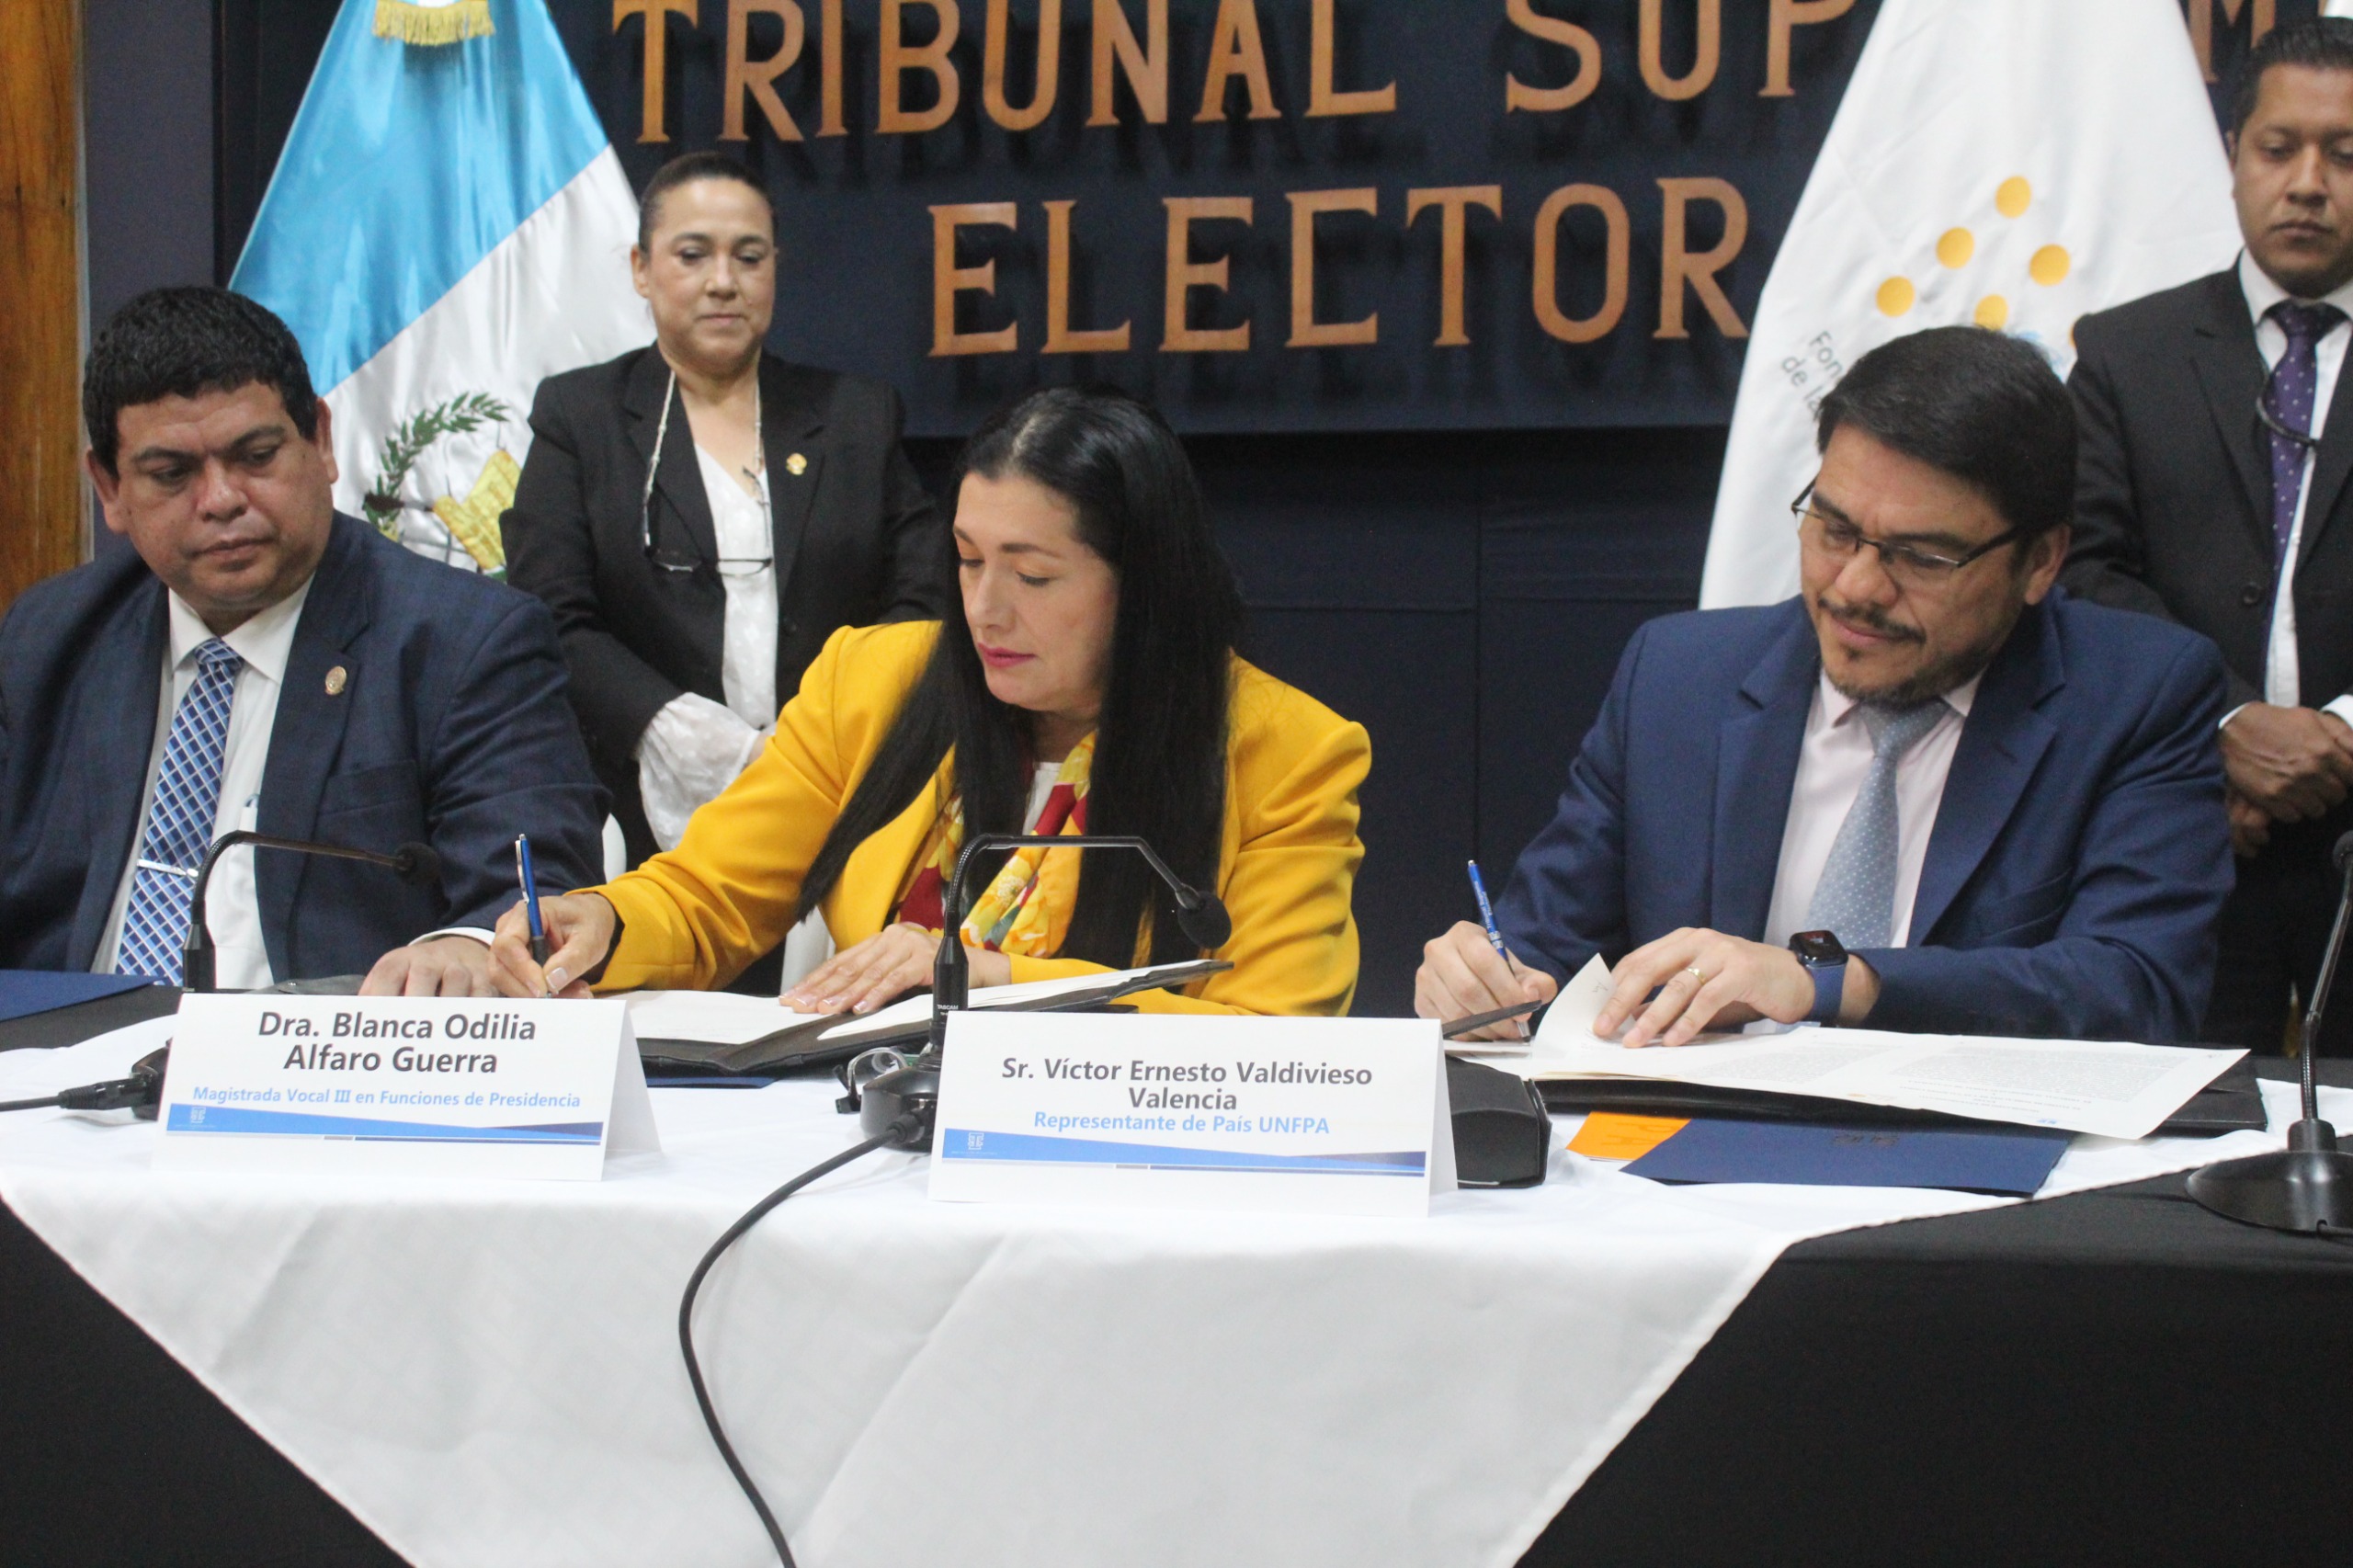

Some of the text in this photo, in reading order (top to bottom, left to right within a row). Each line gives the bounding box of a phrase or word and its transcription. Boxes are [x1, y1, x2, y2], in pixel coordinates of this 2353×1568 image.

[613, 0, 1395, 143] TRIBUNAL
[1781, 356, 1808, 387] de
[258, 1011, 536, 1040] Dra. Blanca Odilia
[283, 1042, 497, 1074] Alfaro Guerra
[1002, 1057, 1373, 1085] Sr. Víctor Ernesto Valdivieso
[192, 1085, 581, 1108] Magistrada Vocal III en Funciones de Presidencia
[1129, 1086, 1237, 1110] Valencia
[1034, 1110, 1330, 1135] Representante de País UNFPA
